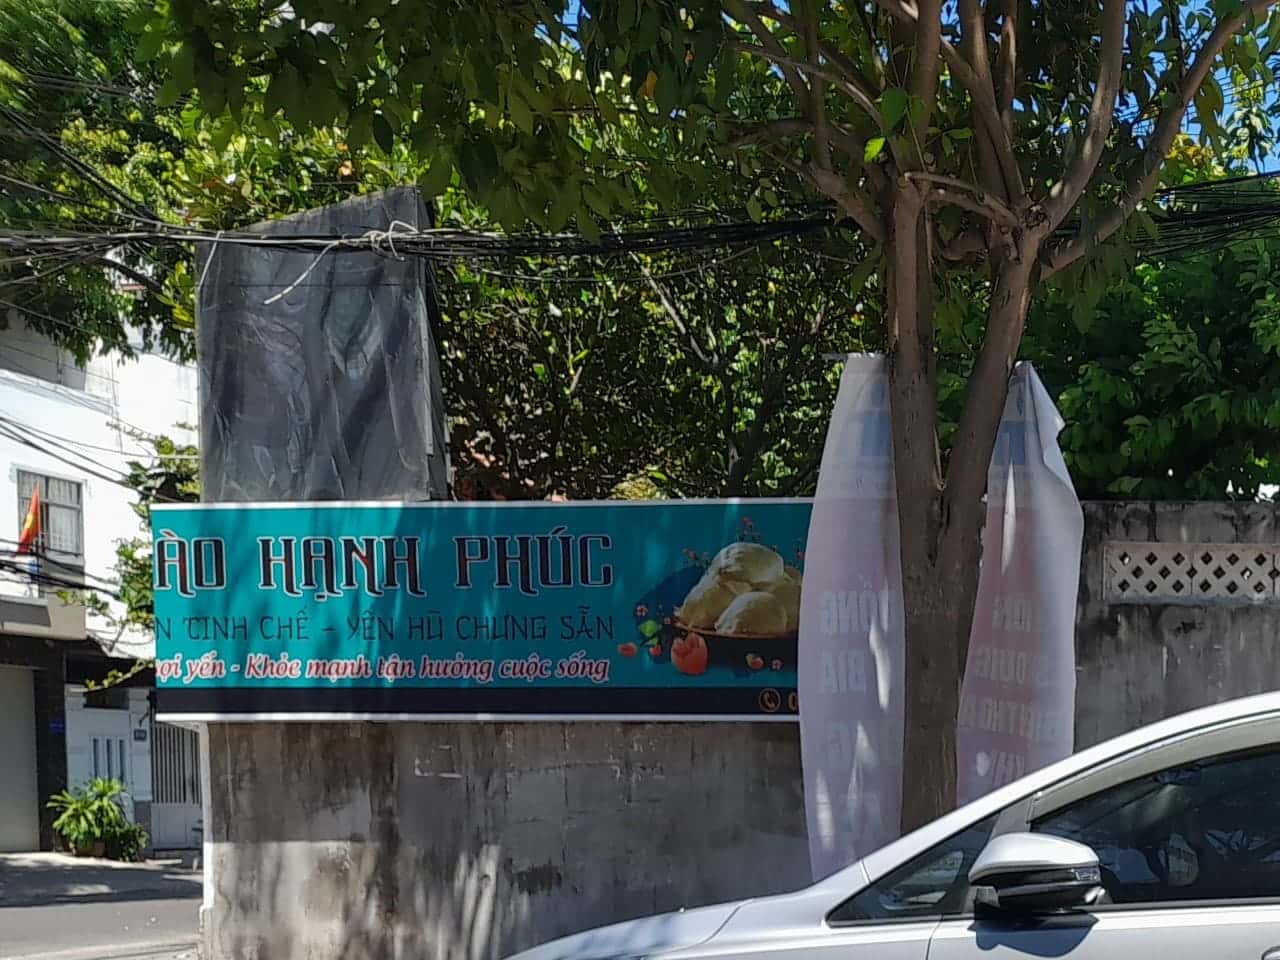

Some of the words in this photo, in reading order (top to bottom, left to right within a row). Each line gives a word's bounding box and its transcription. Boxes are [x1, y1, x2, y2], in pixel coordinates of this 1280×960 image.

[154, 529, 227, 597] ÀO
[257, 536, 427, 602] HẠNH
[452, 525, 613, 597] PHÚC
[408, 609, 443, 641] HŨ
[560, 604, 614, 641] SẴN
[186, 650, 225, 683] yến
[246, 652, 302, 678] Khỏe
[306, 655, 371, 683] mạnh
[377, 653, 415, 682] tận
[419, 652, 494, 683] hưởng
[500, 652, 551, 682] cuộc
[555, 650, 608, 683] sống
